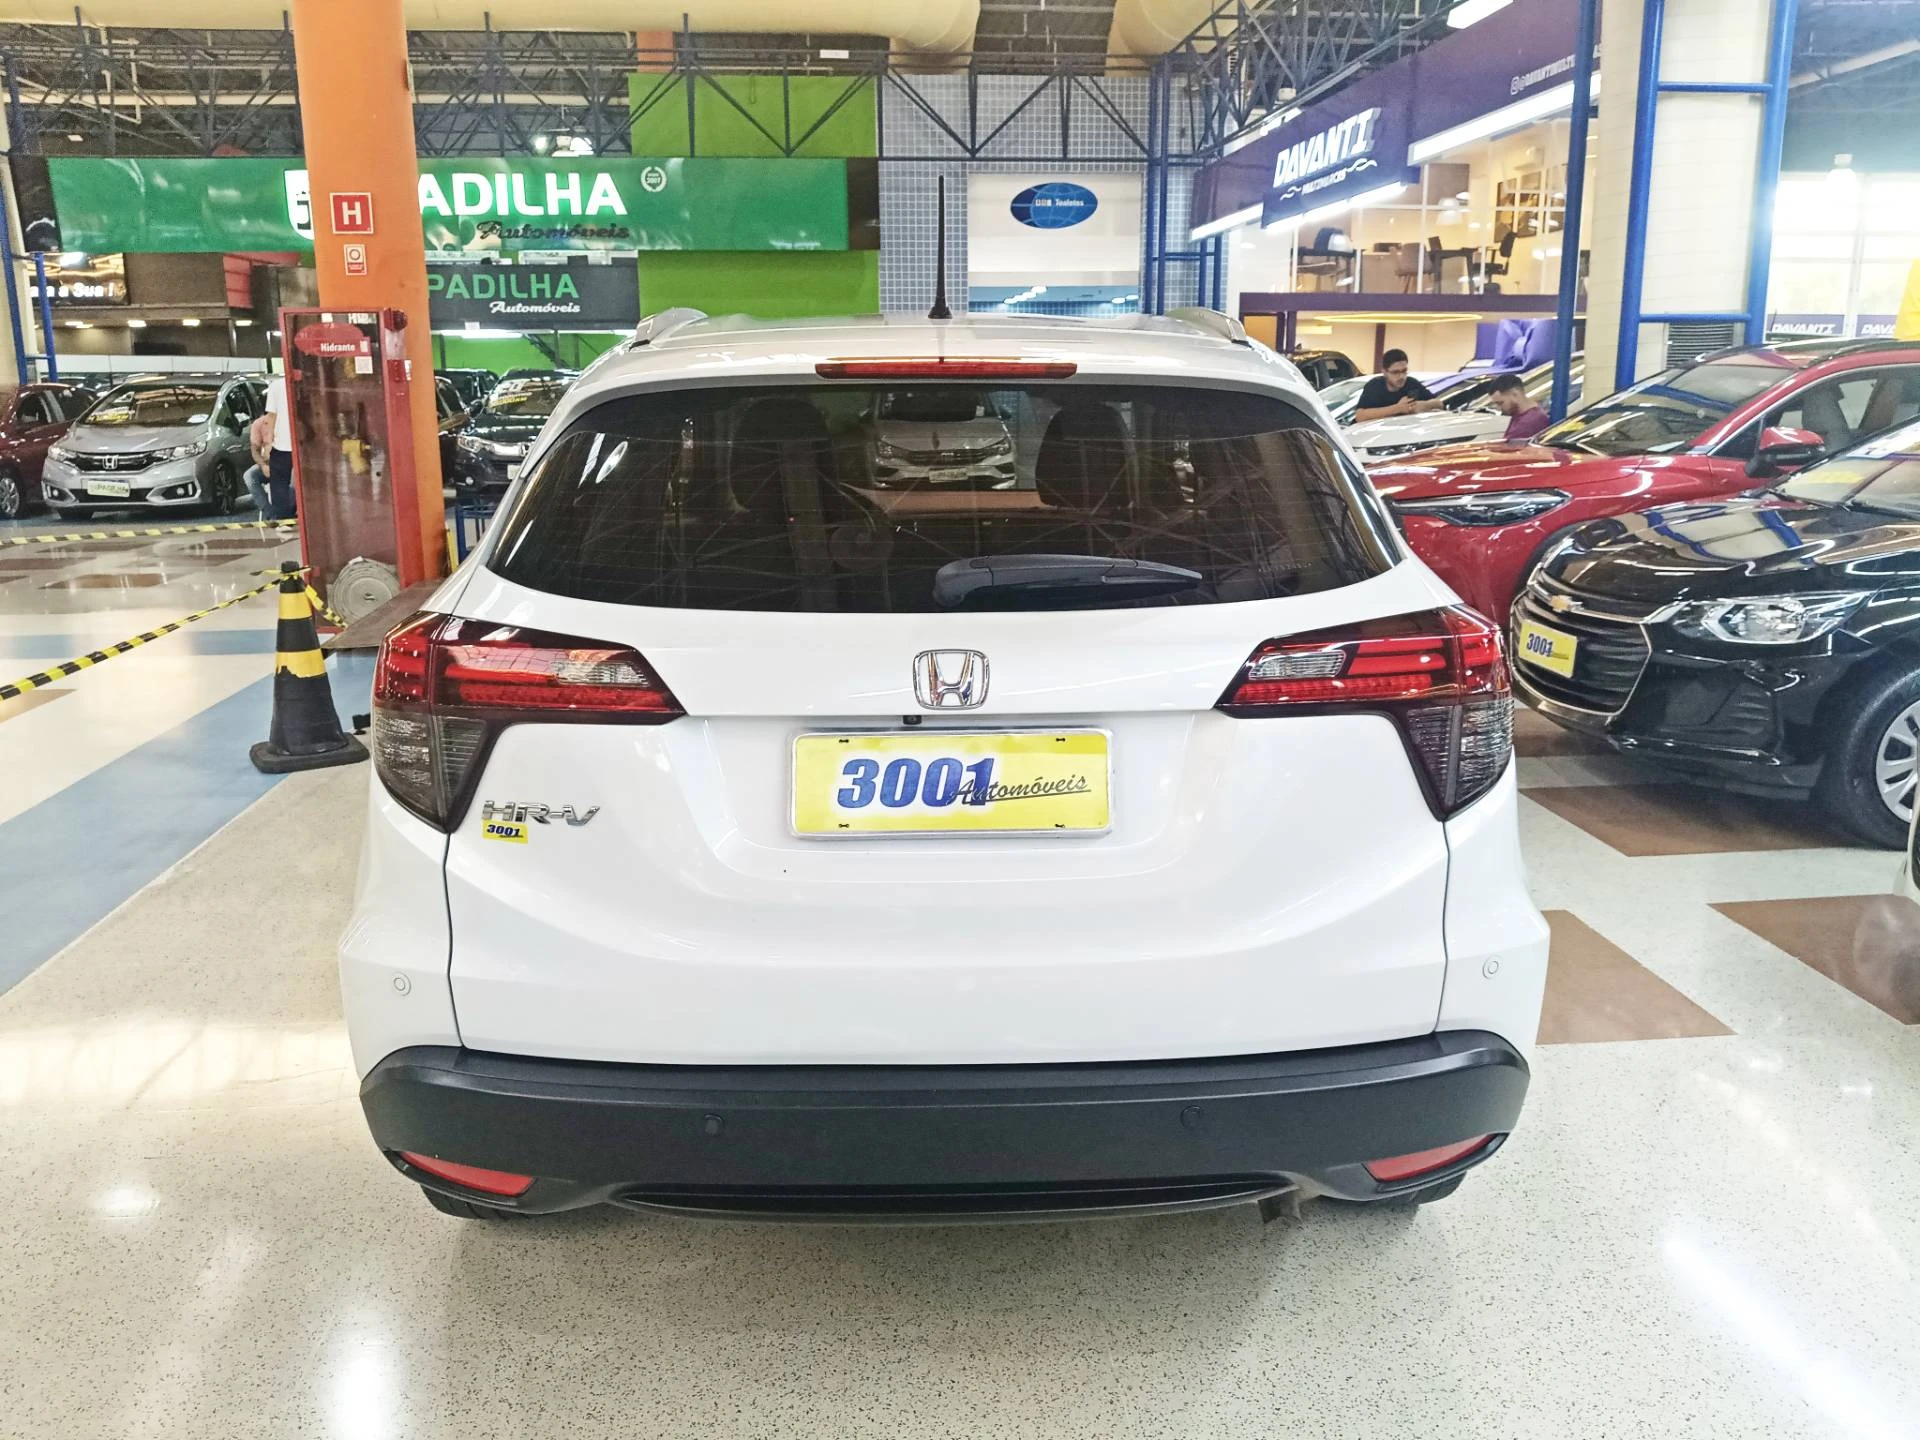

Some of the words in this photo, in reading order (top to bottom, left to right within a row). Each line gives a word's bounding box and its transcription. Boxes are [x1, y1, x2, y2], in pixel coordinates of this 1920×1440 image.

[1273, 108, 1377, 188] DAVANTI
[417, 172, 628, 216] ADILHA
[342, 201, 362, 225] H
[476, 220, 630, 240] Automóveis
[427, 273, 580, 299] PADILHA
[488, 301, 581, 314] Automóveis
[1771, 323, 1836, 335] DAVANTI
[320, 342, 356, 352] Hidrante
[1526, 632, 1554, 657] 3001
[837, 757, 995, 808] 3001
[952, 773, 1089, 805] Automóveis
[482, 800, 600, 827] HR-V
[486, 824, 521, 837] 3001
